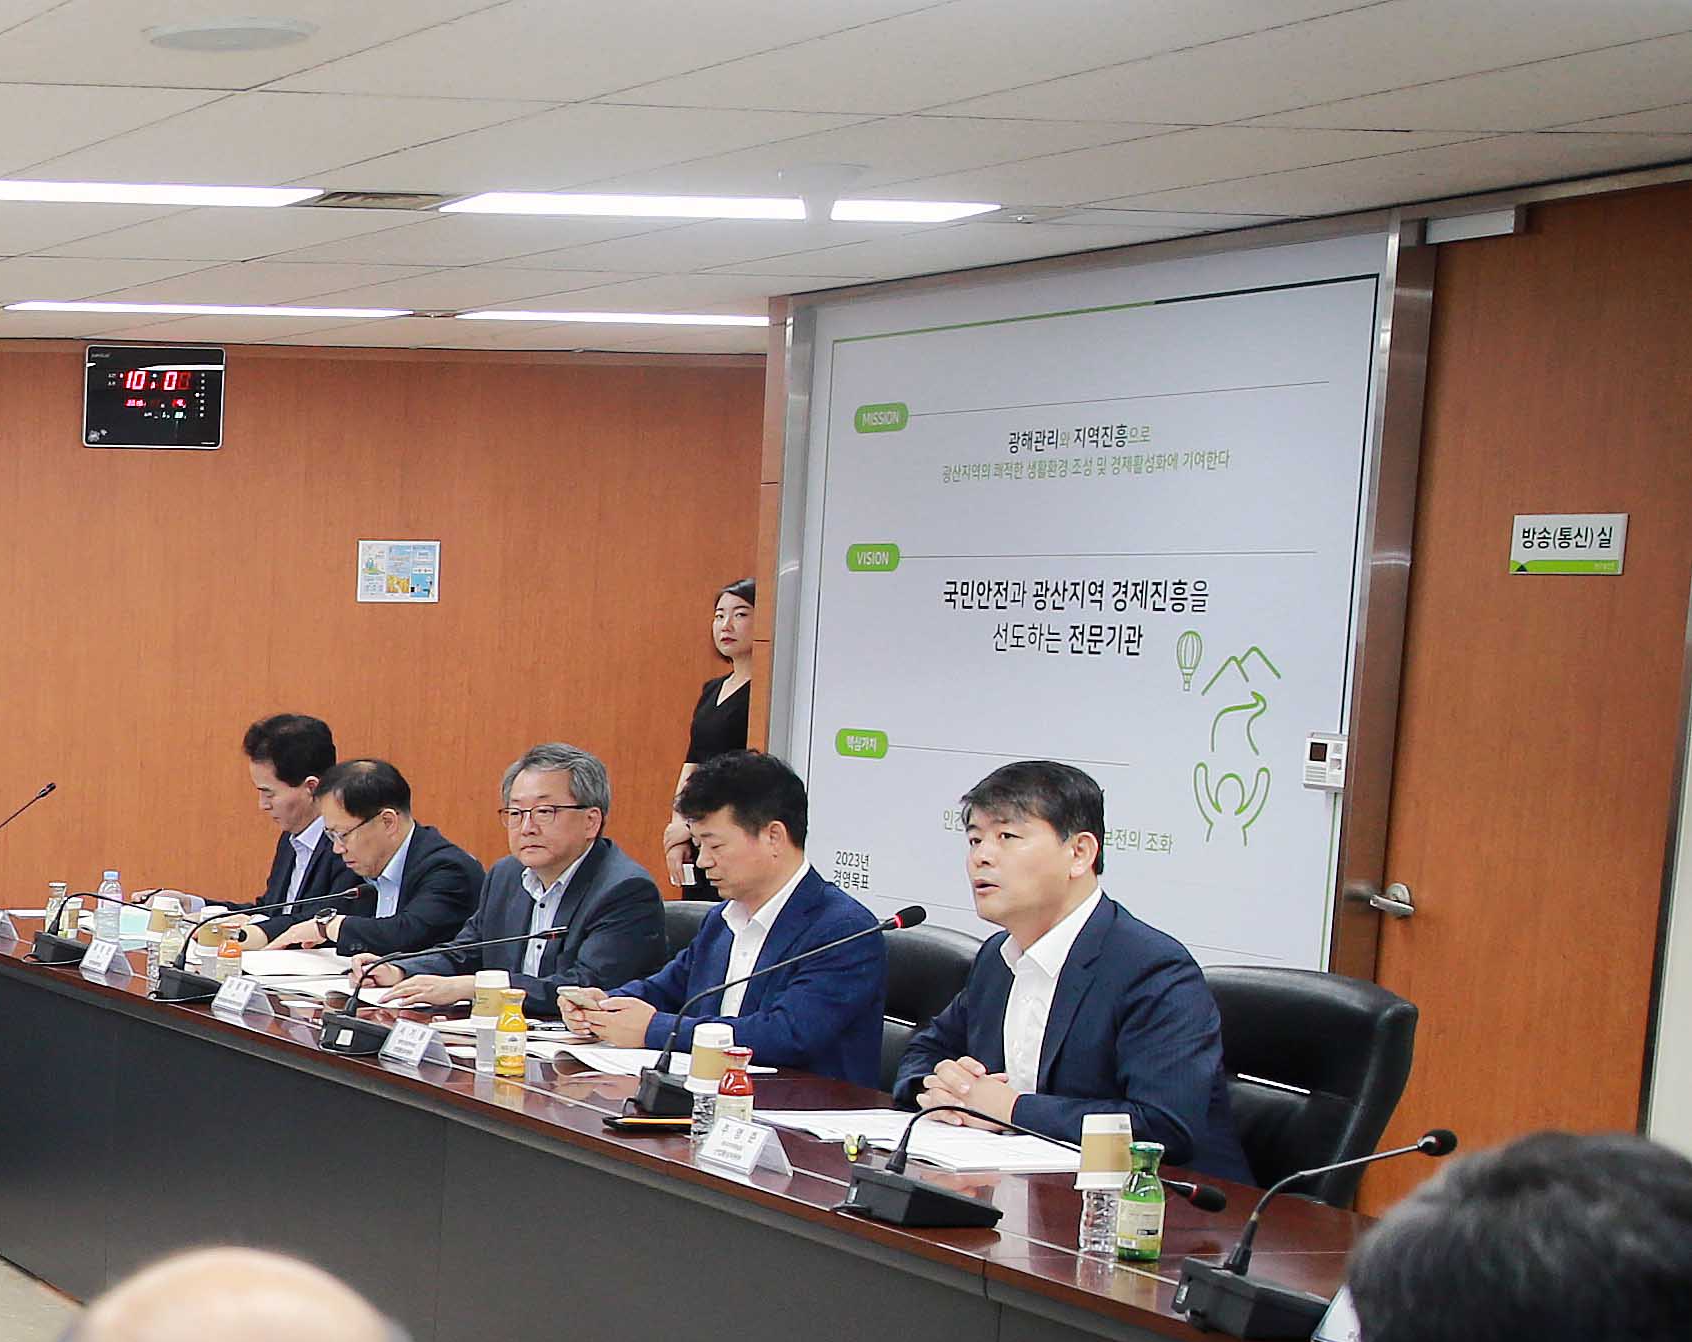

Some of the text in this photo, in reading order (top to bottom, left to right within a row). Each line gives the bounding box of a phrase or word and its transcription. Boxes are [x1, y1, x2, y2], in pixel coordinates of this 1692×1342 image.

[862, 410, 900, 426] MISSION
[1008, 424, 1151, 454] 광해관리와 지역진흥으로
[941, 463, 990, 484] 광산지역의
[1071, 458, 1092, 477] 조성
[1096, 456, 1107, 475] 및
[1110, 452, 1178, 476] 경제활성화에
[1182, 449, 1230, 471] 기여한다
[856, 551, 889, 566] VISION
[942, 578, 1210, 614] 국민안전과 광산지역 경제진흥을
[992, 621, 1144, 657] 선도하는 전문기관
[1144, 831, 1173, 855] 조화
[835, 850, 870, 872] 2023년
[833, 869, 871, 891] 경영목표
